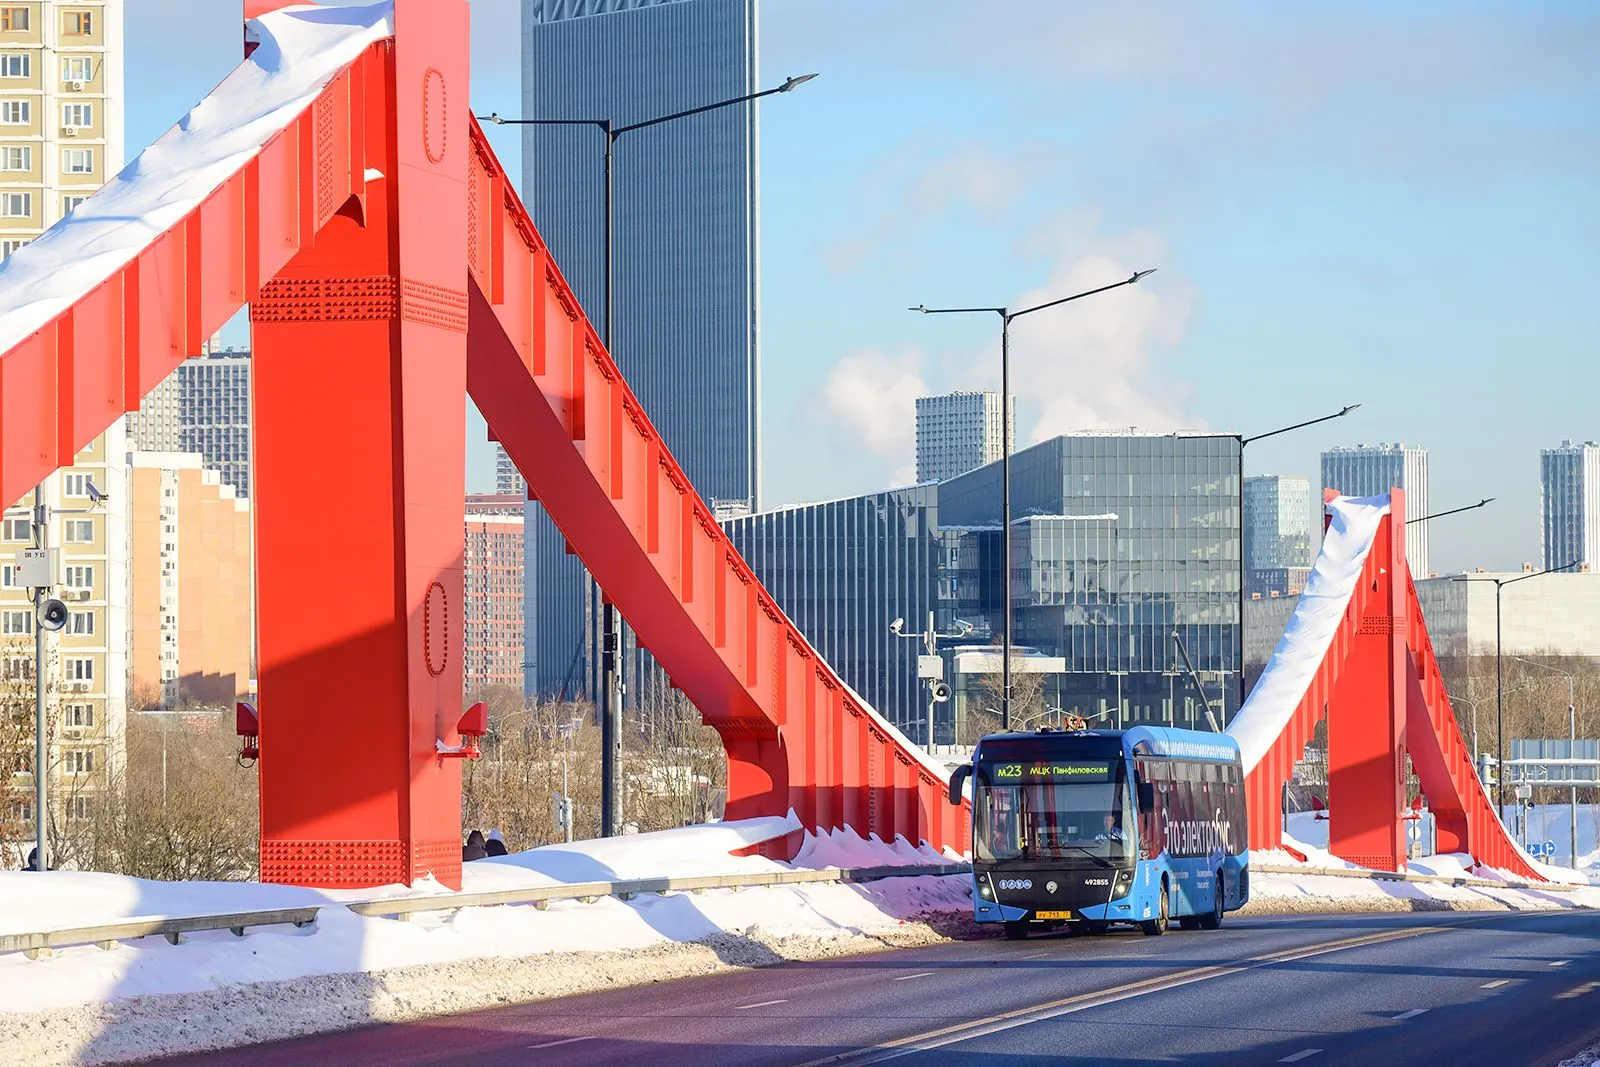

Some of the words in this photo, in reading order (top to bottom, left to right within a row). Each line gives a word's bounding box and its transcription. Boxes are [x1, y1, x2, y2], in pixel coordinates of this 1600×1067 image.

[997, 765, 1022, 777] м23
[1029, 767, 1050, 775] МЦК
[1053, 766, 1108, 775] Панфиловская
[1161, 808, 1180, 855] Это
